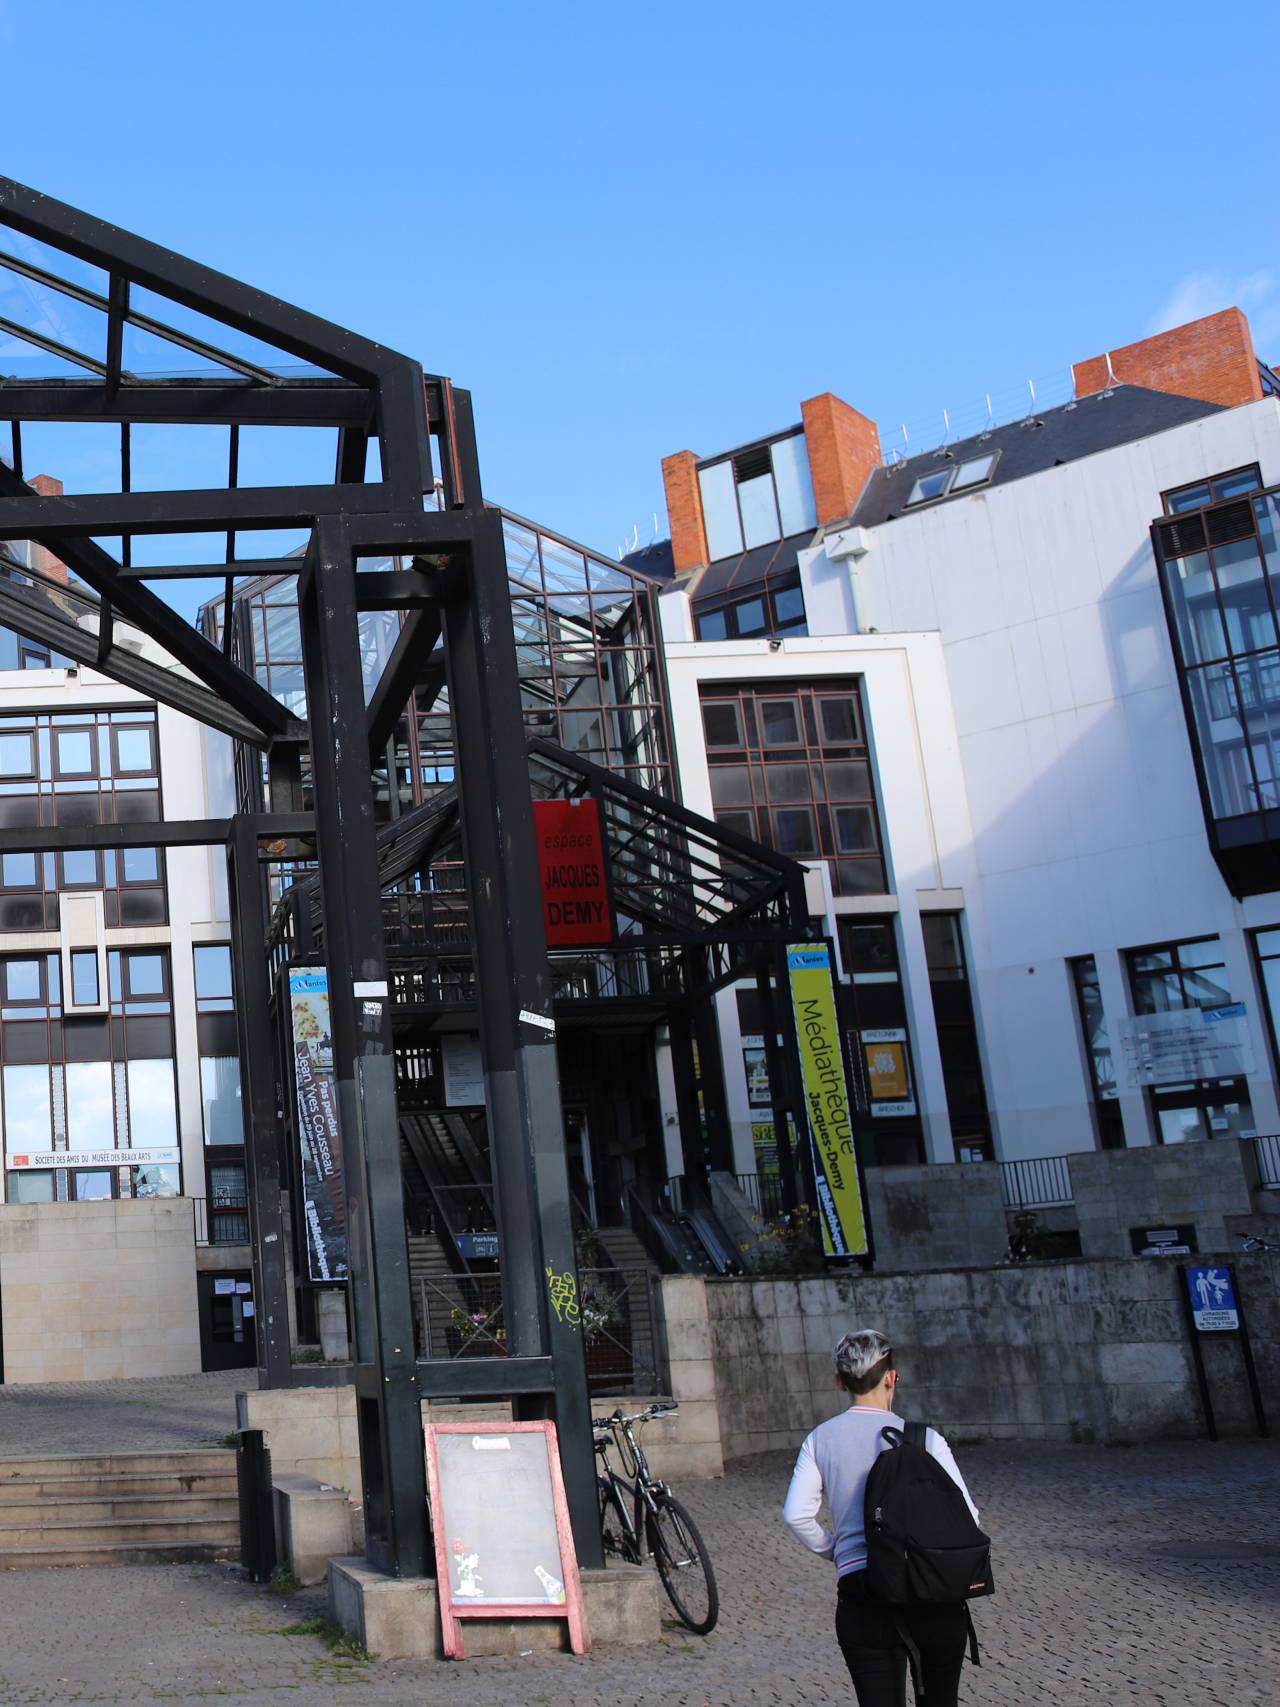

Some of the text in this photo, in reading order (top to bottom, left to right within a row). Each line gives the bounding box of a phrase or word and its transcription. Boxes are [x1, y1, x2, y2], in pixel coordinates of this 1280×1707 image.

[544, 834, 593, 850] espace
[545, 864, 600, 889] JACQUES
[547, 901, 605, 926] DEMY
[798, 1000, 853, 1154] Médiathèque
[298, 1053, 312, 1082] Jean
[306, 1083, 320, 1113] Yves
[313, 1115, 334, 1175] Cousseau
[319, 1081, 338, 1137] Pas perdus
[57, 1156, 66, 1164] DES
[67, 1154, 80, 1163] AMIS
[81, 1154, 88, 1163] DU
[111, 1153, 121, 1162] DES
[121, 1152, 137, 1161] BEAUX
[138, 1152, 151, 1160] ARTS
[809, 1092, 844, 1190] Jacques-Demy
[308, 1209, 330, 1280] Bibliothèque
